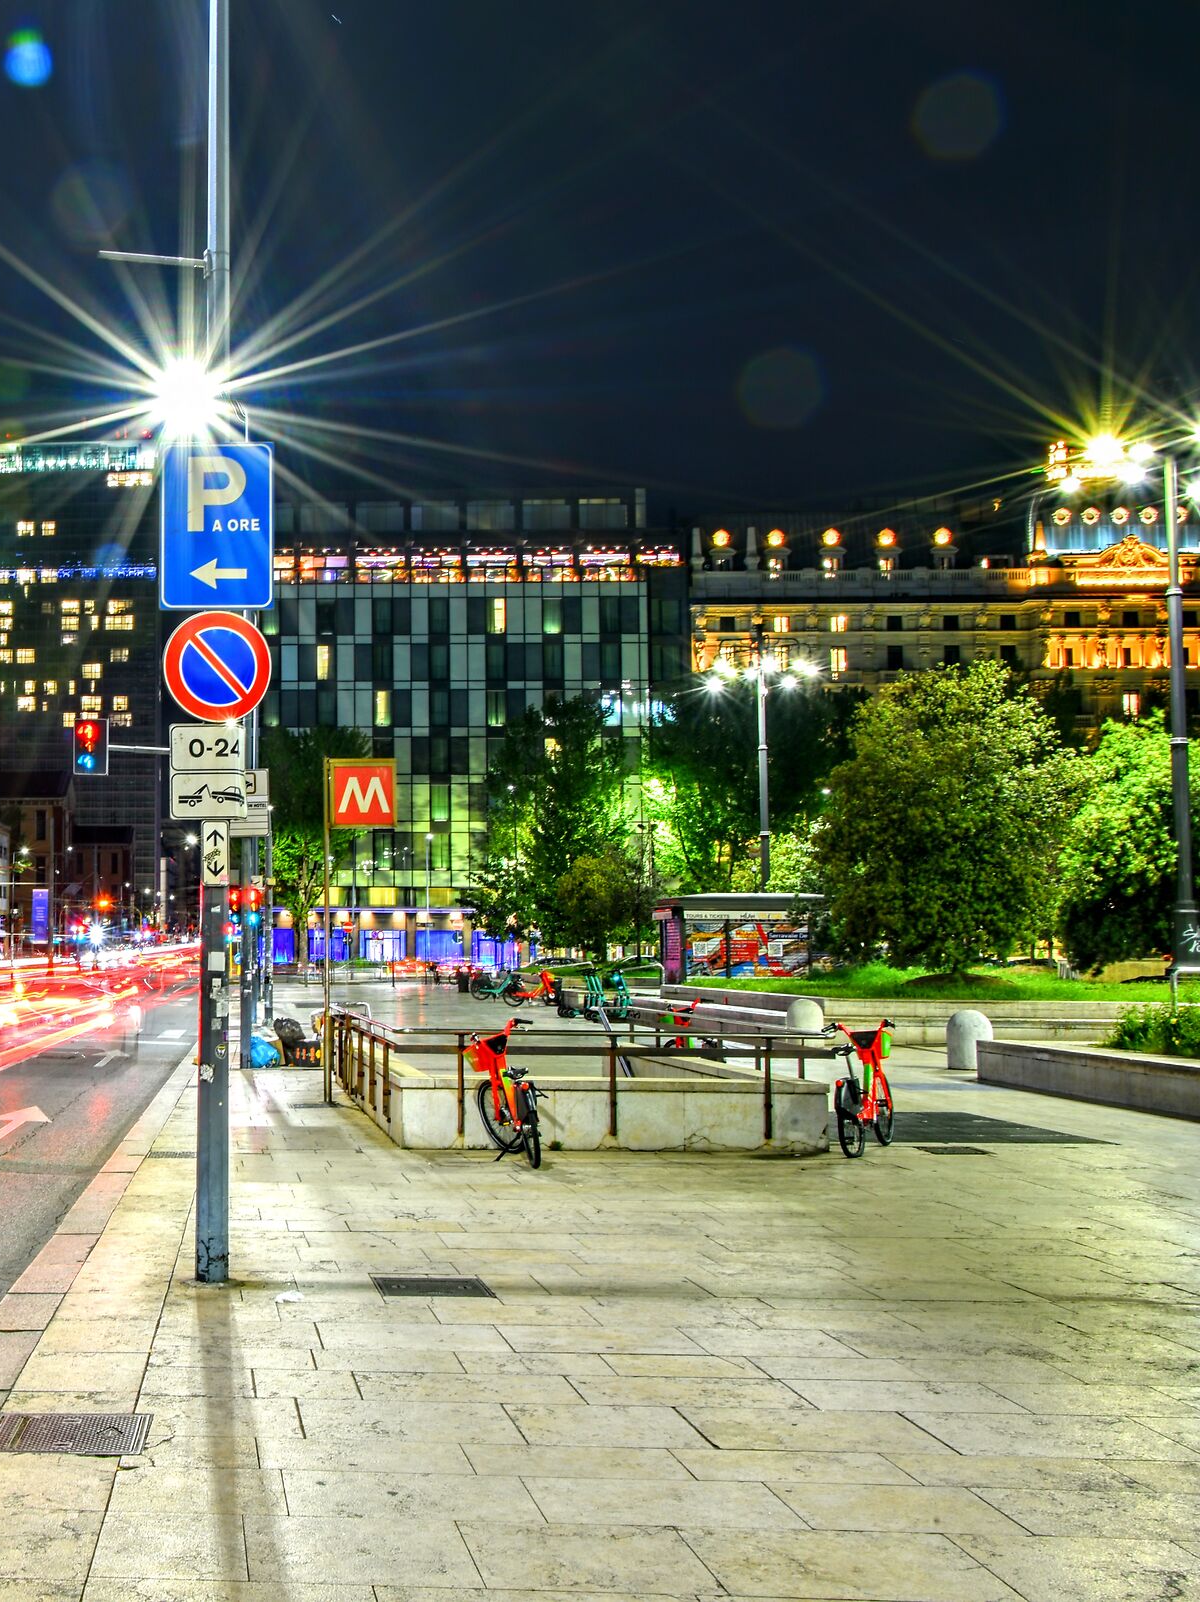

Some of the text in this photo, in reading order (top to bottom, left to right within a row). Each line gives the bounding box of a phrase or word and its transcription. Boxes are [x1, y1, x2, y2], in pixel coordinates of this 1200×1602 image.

[187, 456, 247, 532] P
[211, 518, 260, 532] A ORE
[189, 738, 240, 758] 0-24
[337, 776, 391, 814] M
